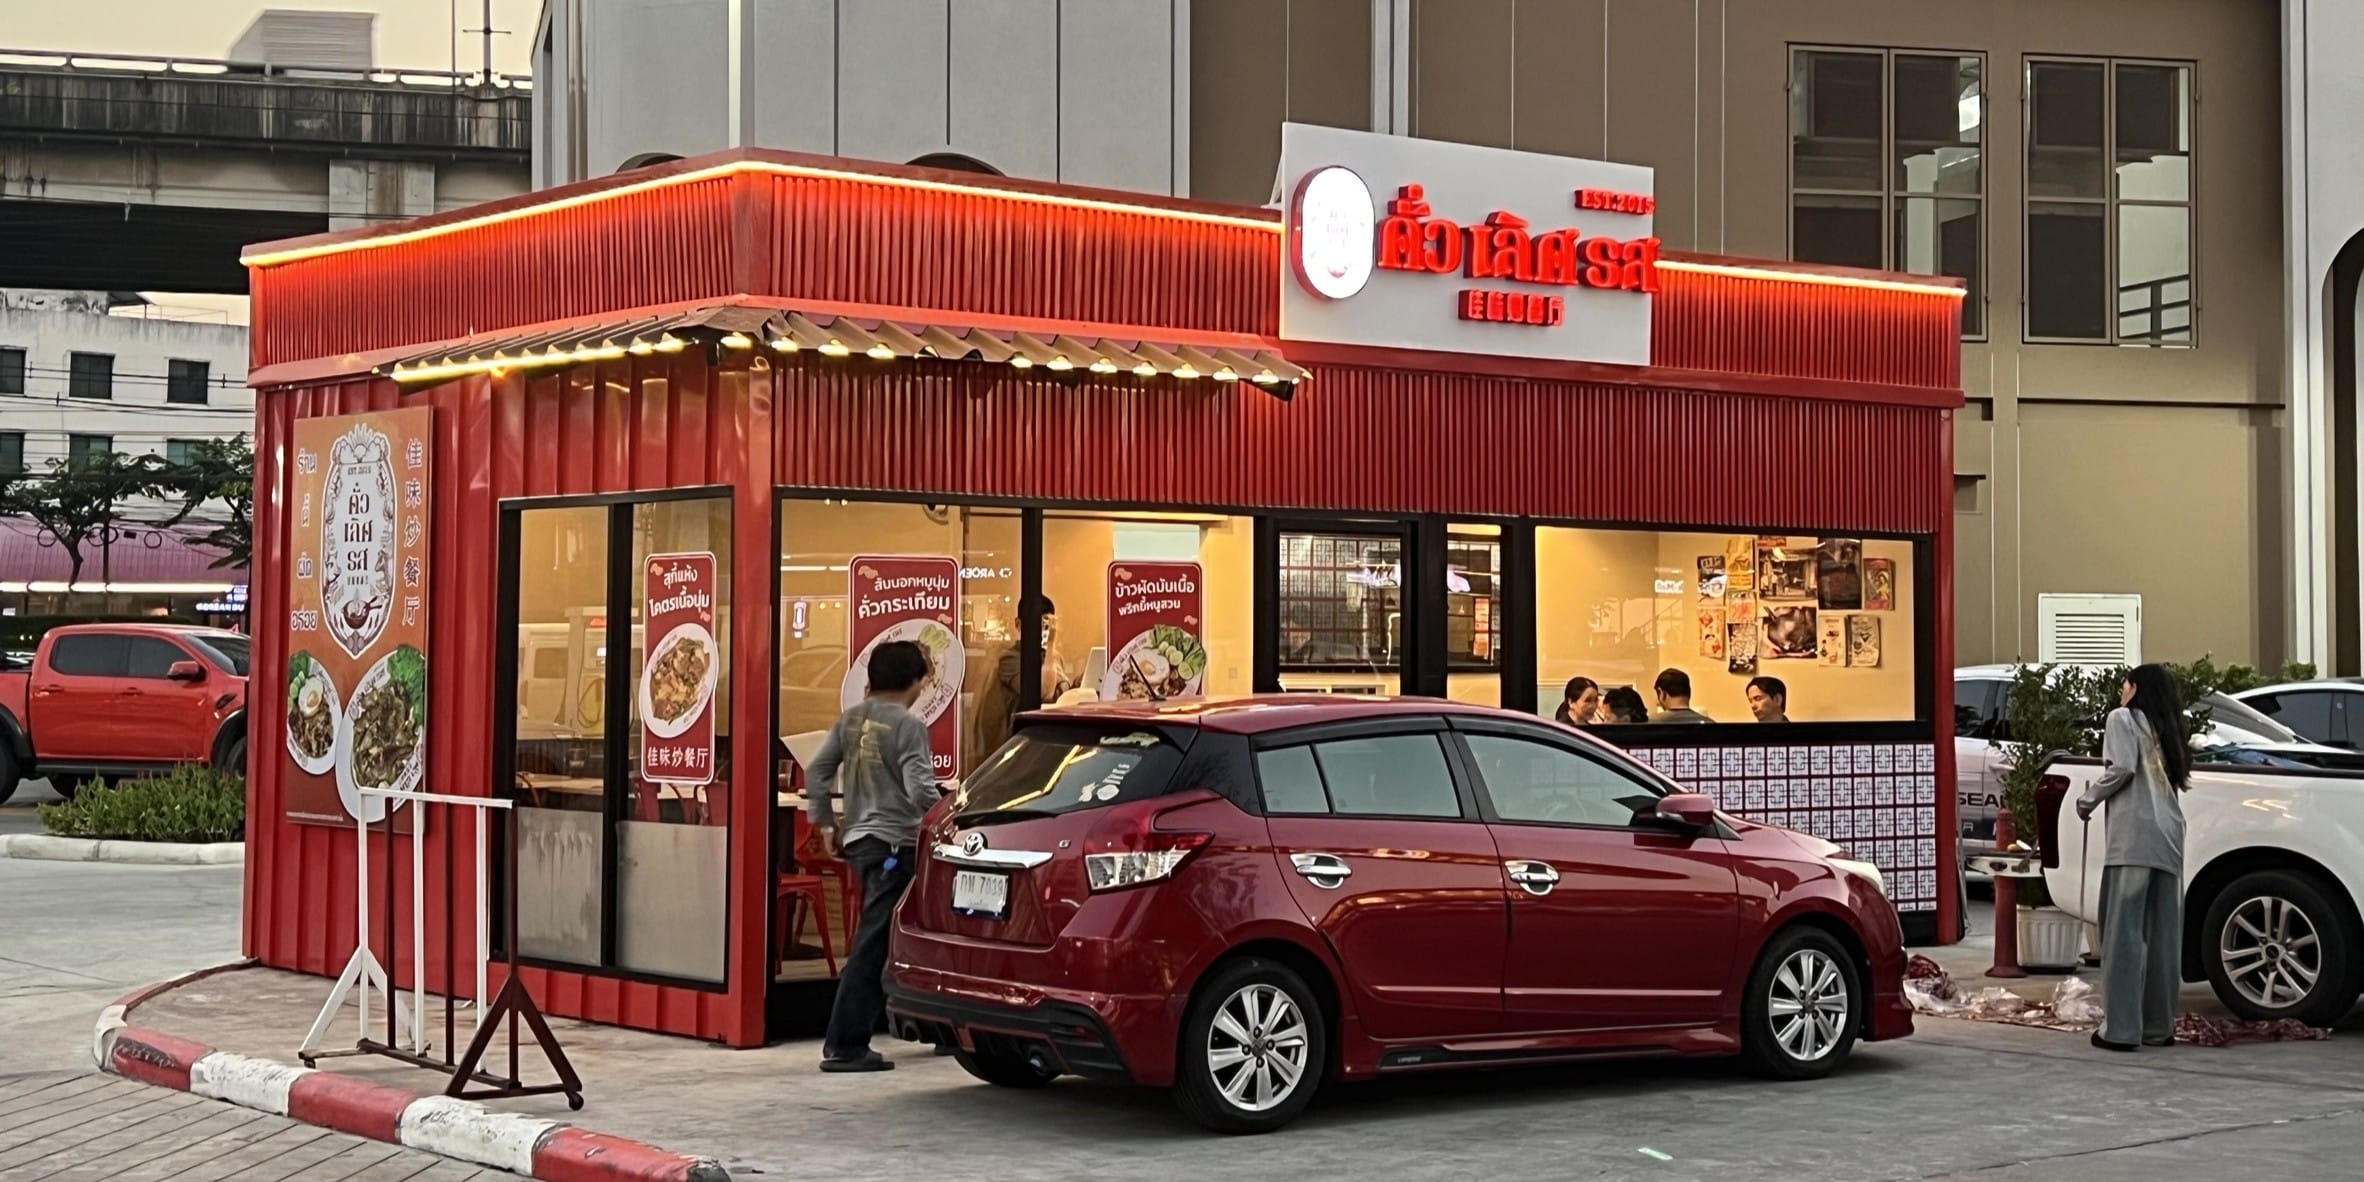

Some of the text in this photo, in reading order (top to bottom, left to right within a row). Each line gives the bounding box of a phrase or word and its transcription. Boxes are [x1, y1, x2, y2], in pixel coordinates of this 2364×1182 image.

[1578, 191, 1656, 215] EST.2015
[663, 561, 698, 590] สุกี้แห้ง
[873, 574, 950, 593] สันนอกหมูนุ่ม
[1115, 573, 1195, 598] ข้าวผัดมันเนื้อ
[648, 585, 710, 617] โคตรเนื้อนุ่ม
[857, 590, 951, 619] คั่วกระเทียม
[1118, 595, 1181, 616] พริกขี้หนูสวน
[647, 745, 709, 768] 佳味炒餐厅
[1958, 791, 2005, 808] SEA
